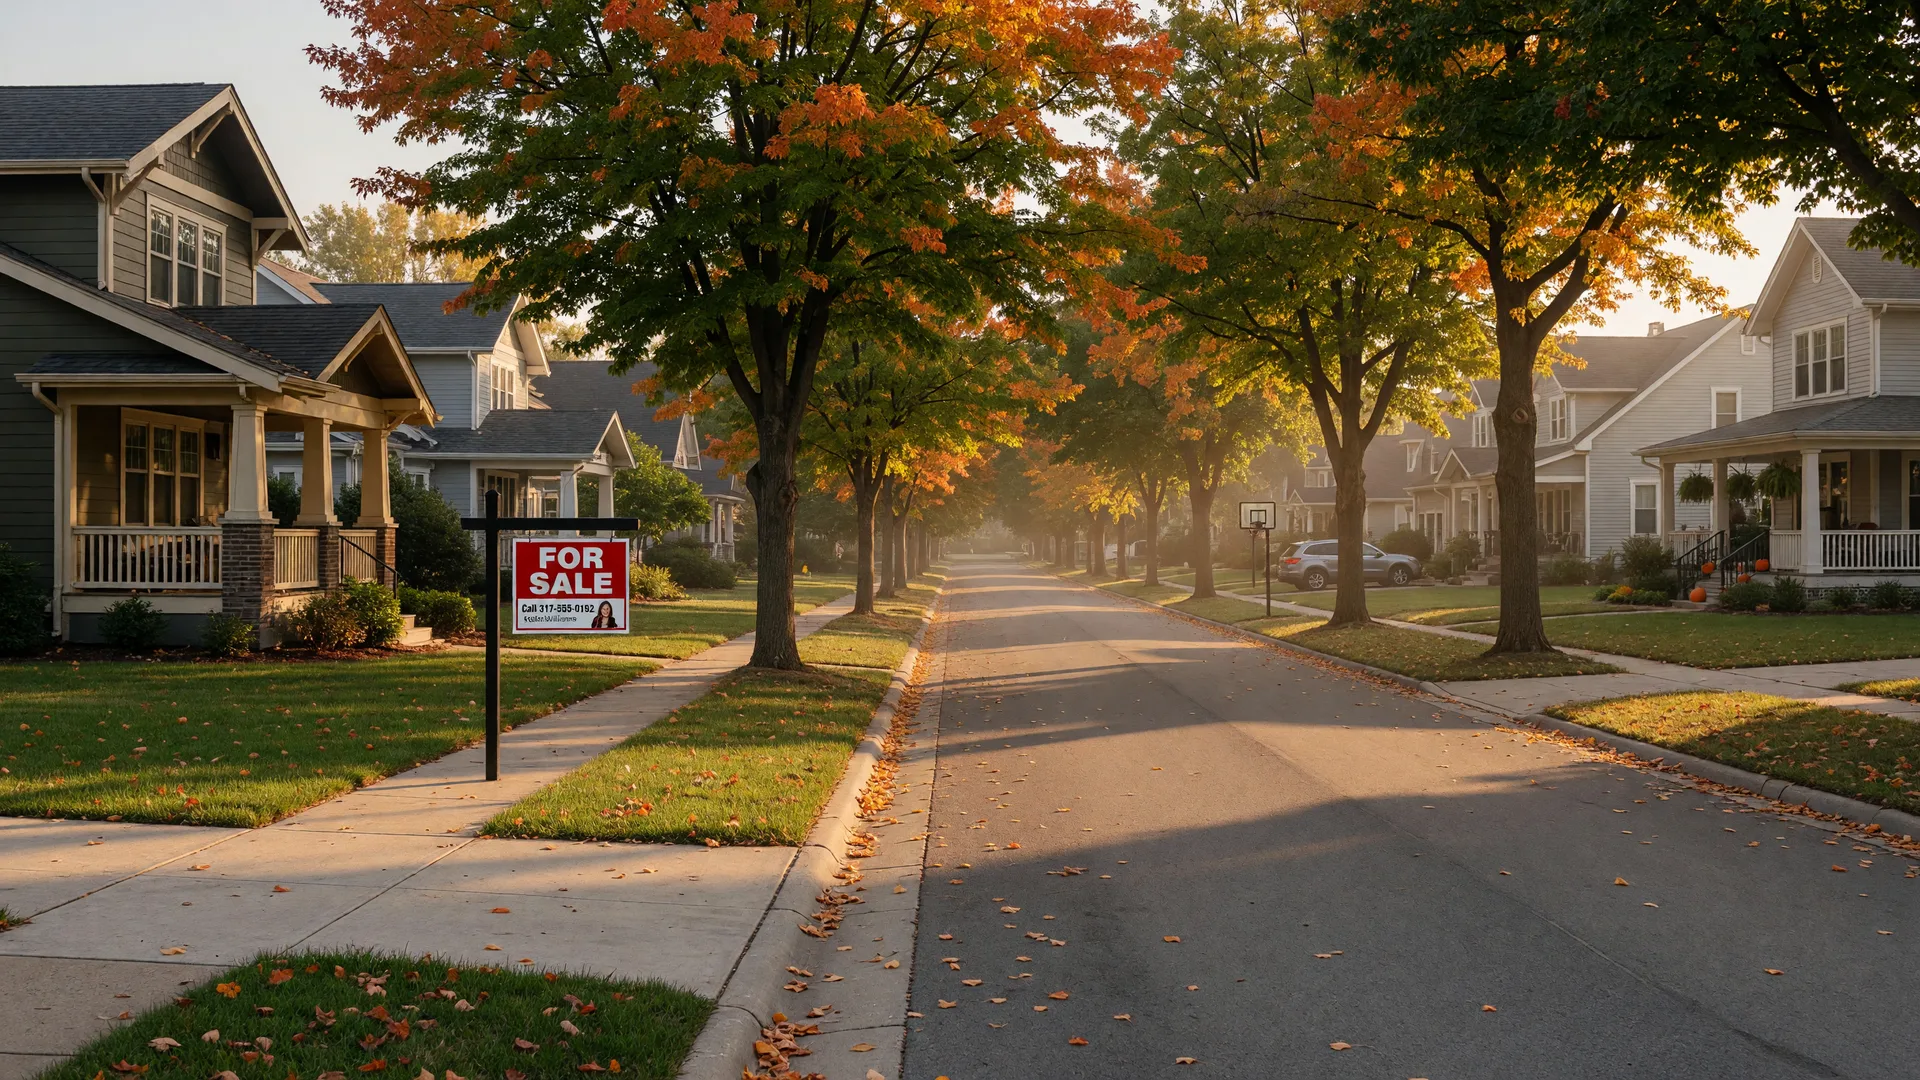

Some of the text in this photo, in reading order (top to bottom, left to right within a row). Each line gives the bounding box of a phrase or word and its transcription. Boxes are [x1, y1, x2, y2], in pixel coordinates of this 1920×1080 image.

[539, 546, 603, 569] FOR
[529, 572, 612, 595] SALE
[522, 604, 537, 613] Call
